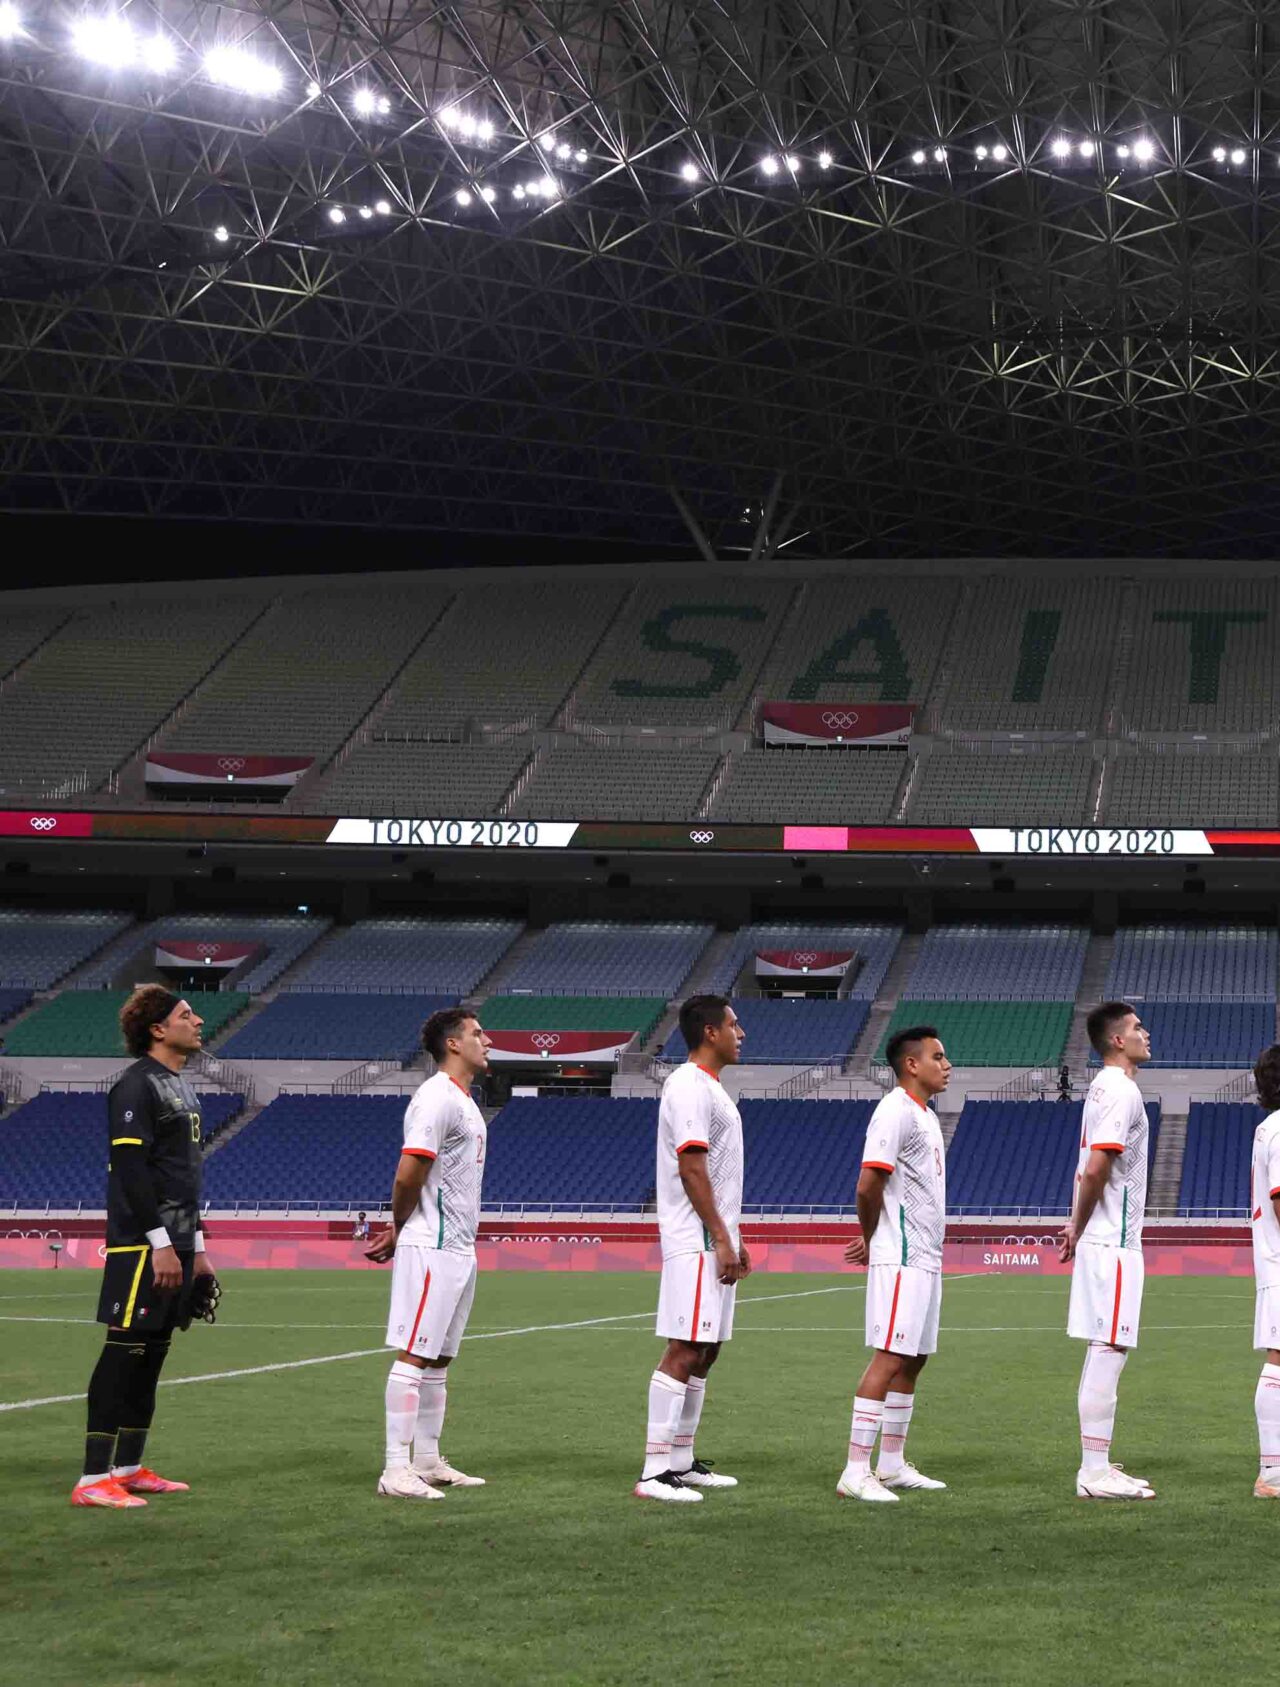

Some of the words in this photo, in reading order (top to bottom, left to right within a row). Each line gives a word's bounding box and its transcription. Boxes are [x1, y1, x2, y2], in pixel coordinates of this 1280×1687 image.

[368, 819, 463, 846] TOKYO
[470, 820, 539, 847] 2020
[1010, 828, 1100, 853] TOKYO
[1109, 829, 1175, 854] 2020
[983, 1253, 1040, 1265] SAITAMA
